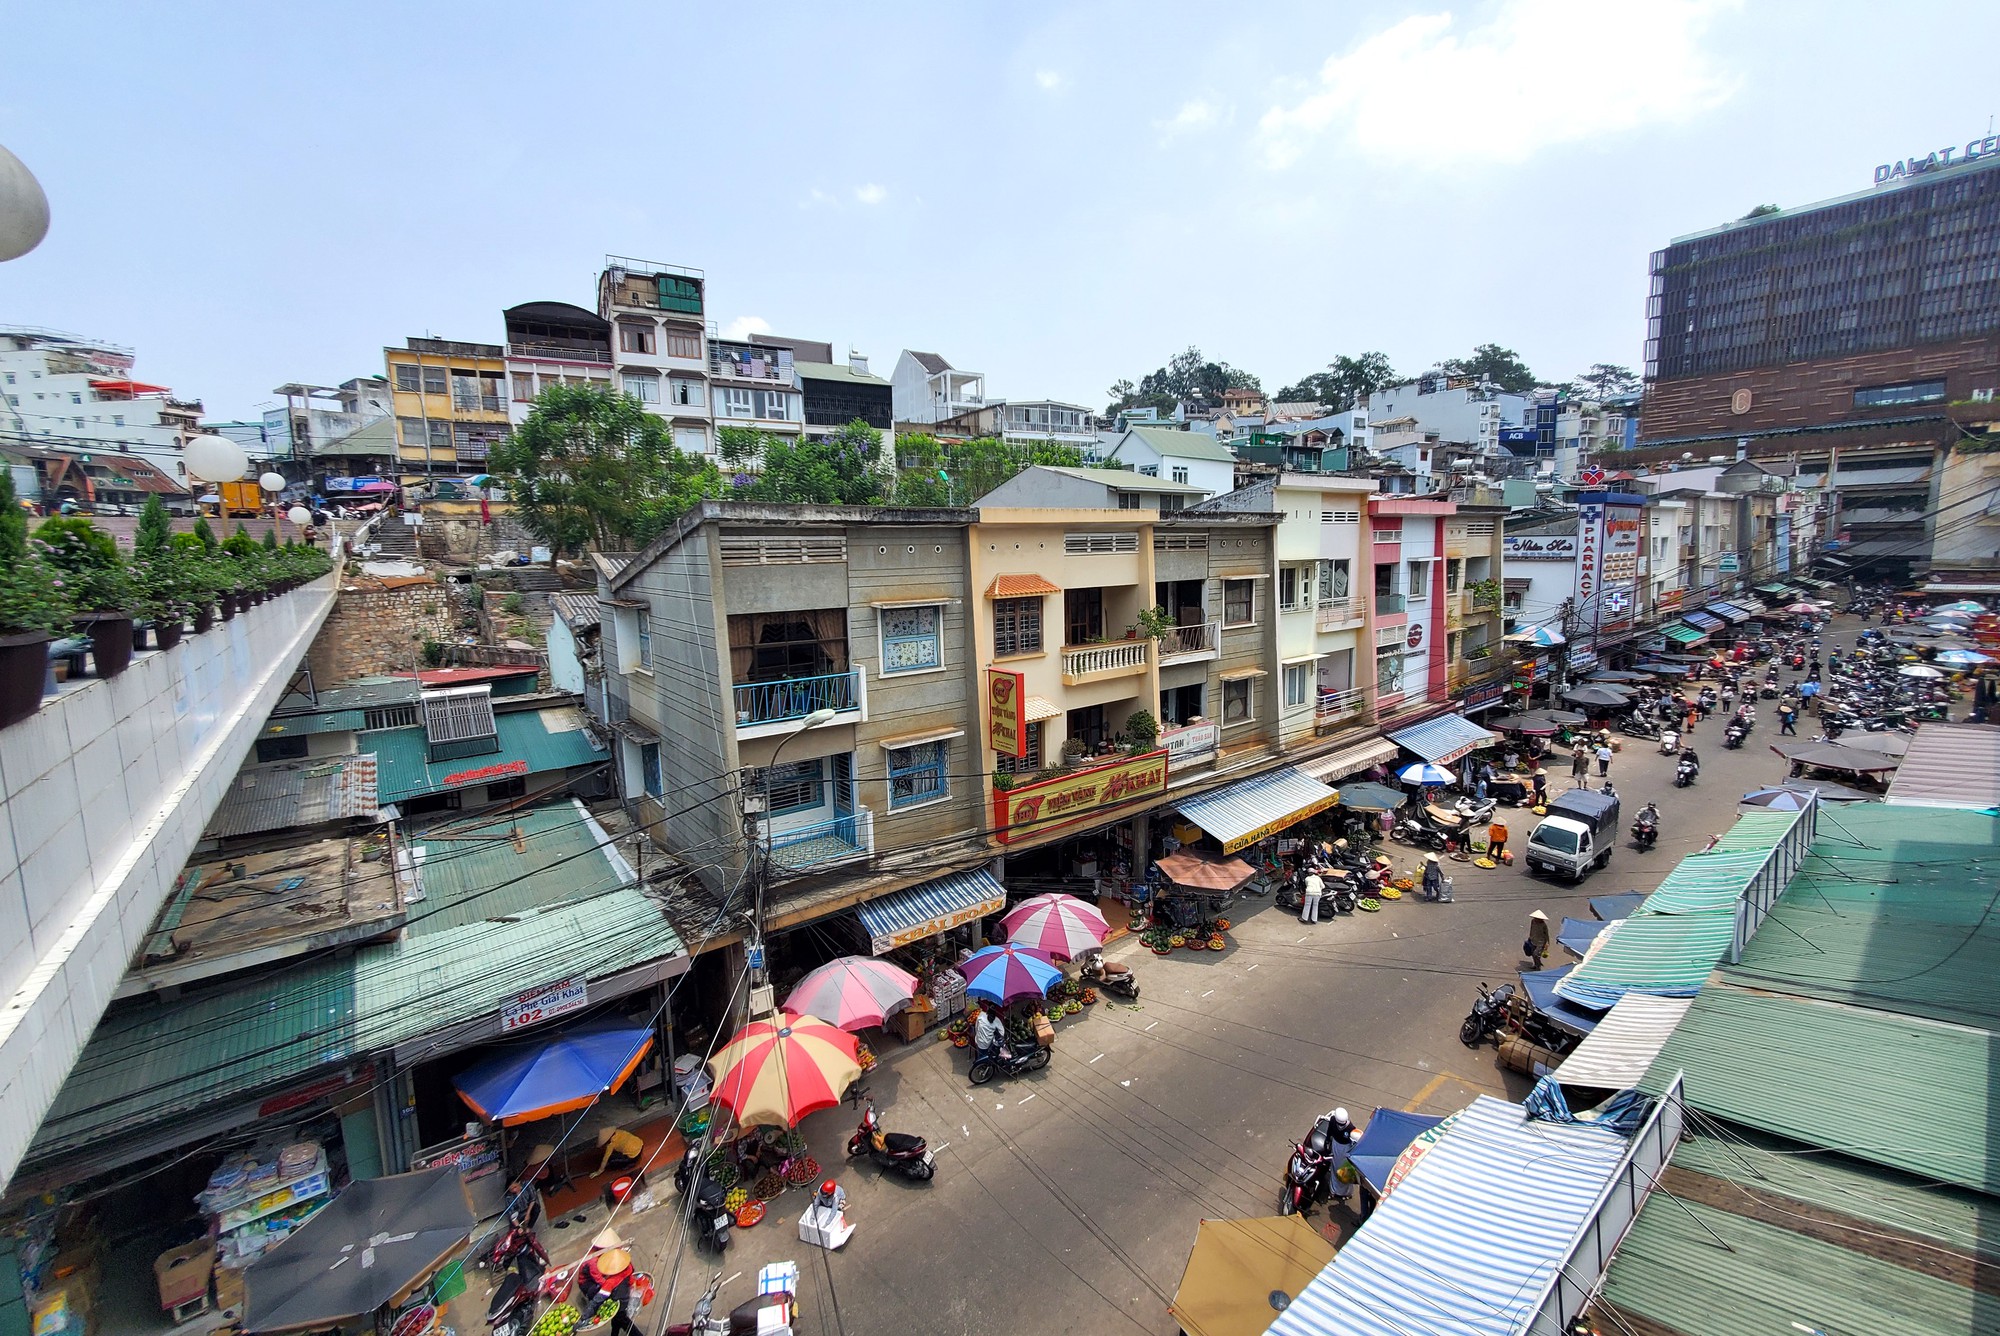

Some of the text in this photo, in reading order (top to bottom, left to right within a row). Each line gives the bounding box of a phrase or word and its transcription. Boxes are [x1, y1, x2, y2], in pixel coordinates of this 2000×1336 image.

[1508, 432, 1524, 440] ACB
[1580, 527, 1595, 599] PHARMACY
[507, 1009, 543, 1028] 102
